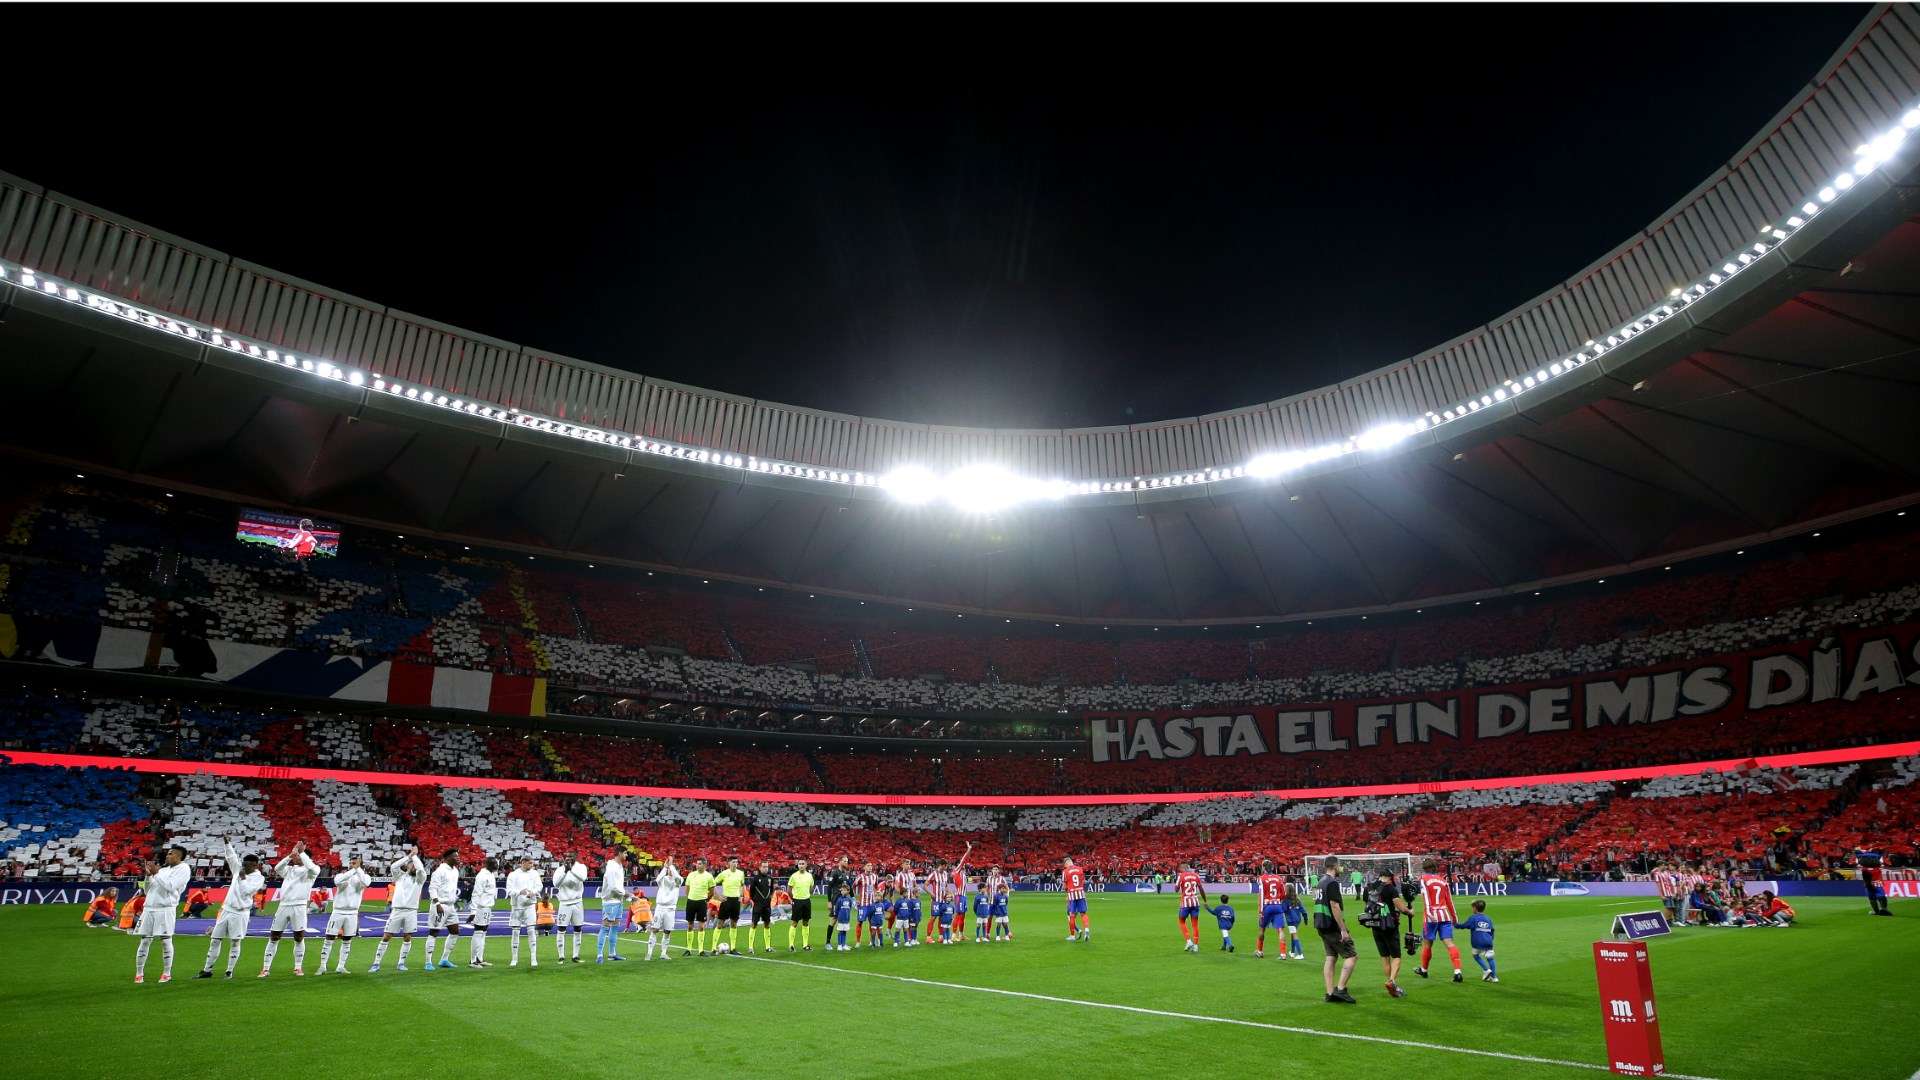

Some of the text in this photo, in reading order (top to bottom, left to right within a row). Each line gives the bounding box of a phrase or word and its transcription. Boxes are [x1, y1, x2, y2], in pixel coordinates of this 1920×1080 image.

[1091, 714, 1269, 763] HASTA
[1277, 710, 1349, 754] EL
[1357, 697, 1460, 748] FIN
[1477, 686, 1572, 739] DE
[1584, 665, 1732, 729] MIS
[258, 767, 290, 778] ATLETI
[1072, 874, 1080, 887] 9
[1088, 883, 1105, 893] AIR
[1184, 881, 1197, 896] 23
[1269, 883, 1277, 898] 5
[1476, 882, 1507, 896] AIR
[2, 888, 104, 905] RIYAD
[1433, 886, 1441, 905] 7
[1600, 950, 1628, 958] Mahou
[1615, 1061, 1644, 1072] Mahou
